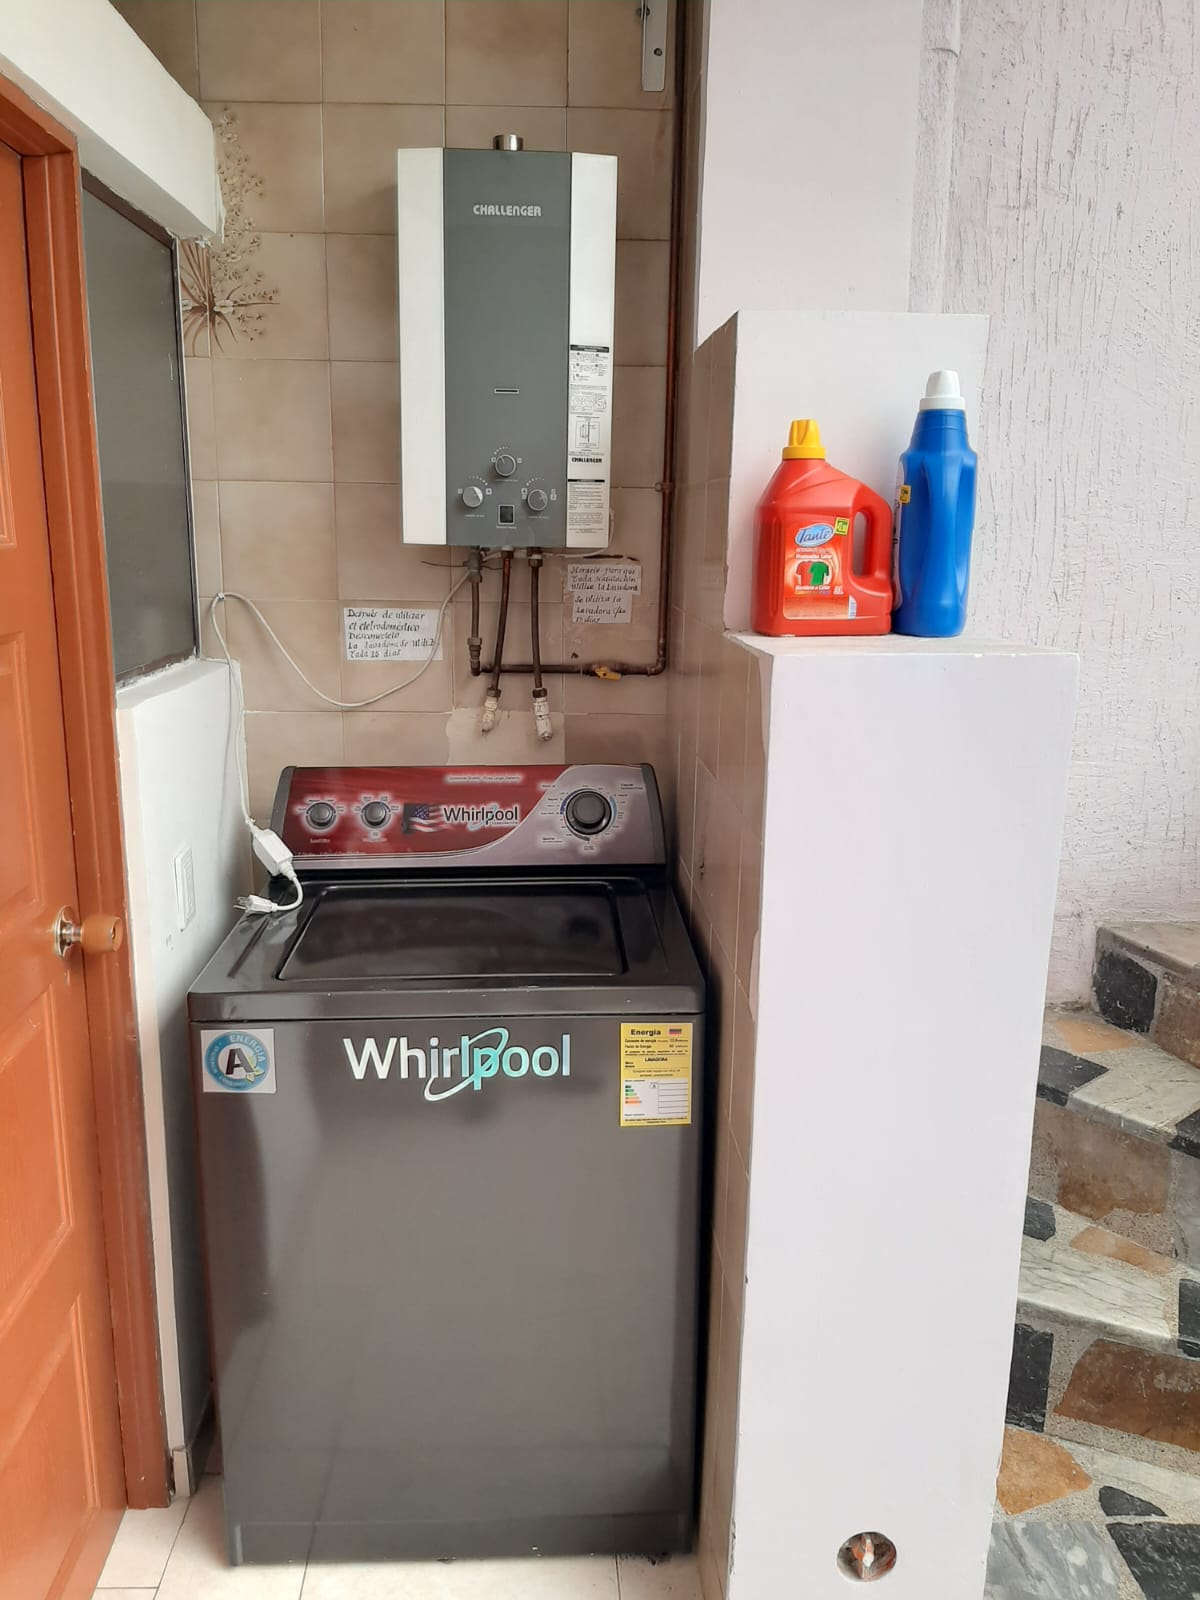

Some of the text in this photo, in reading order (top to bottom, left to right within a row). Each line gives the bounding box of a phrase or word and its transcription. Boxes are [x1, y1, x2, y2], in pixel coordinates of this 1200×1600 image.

[473, 204, 542, 217] CHALLENGER
[800, 526, 831, 544] Tante
[382, 610, 394, 619] de
[443, 804, 518, 826] Whirlpool
[226, 1048, 255, 1075] A
[343, 1031, 571, 1096] Whirlpool
